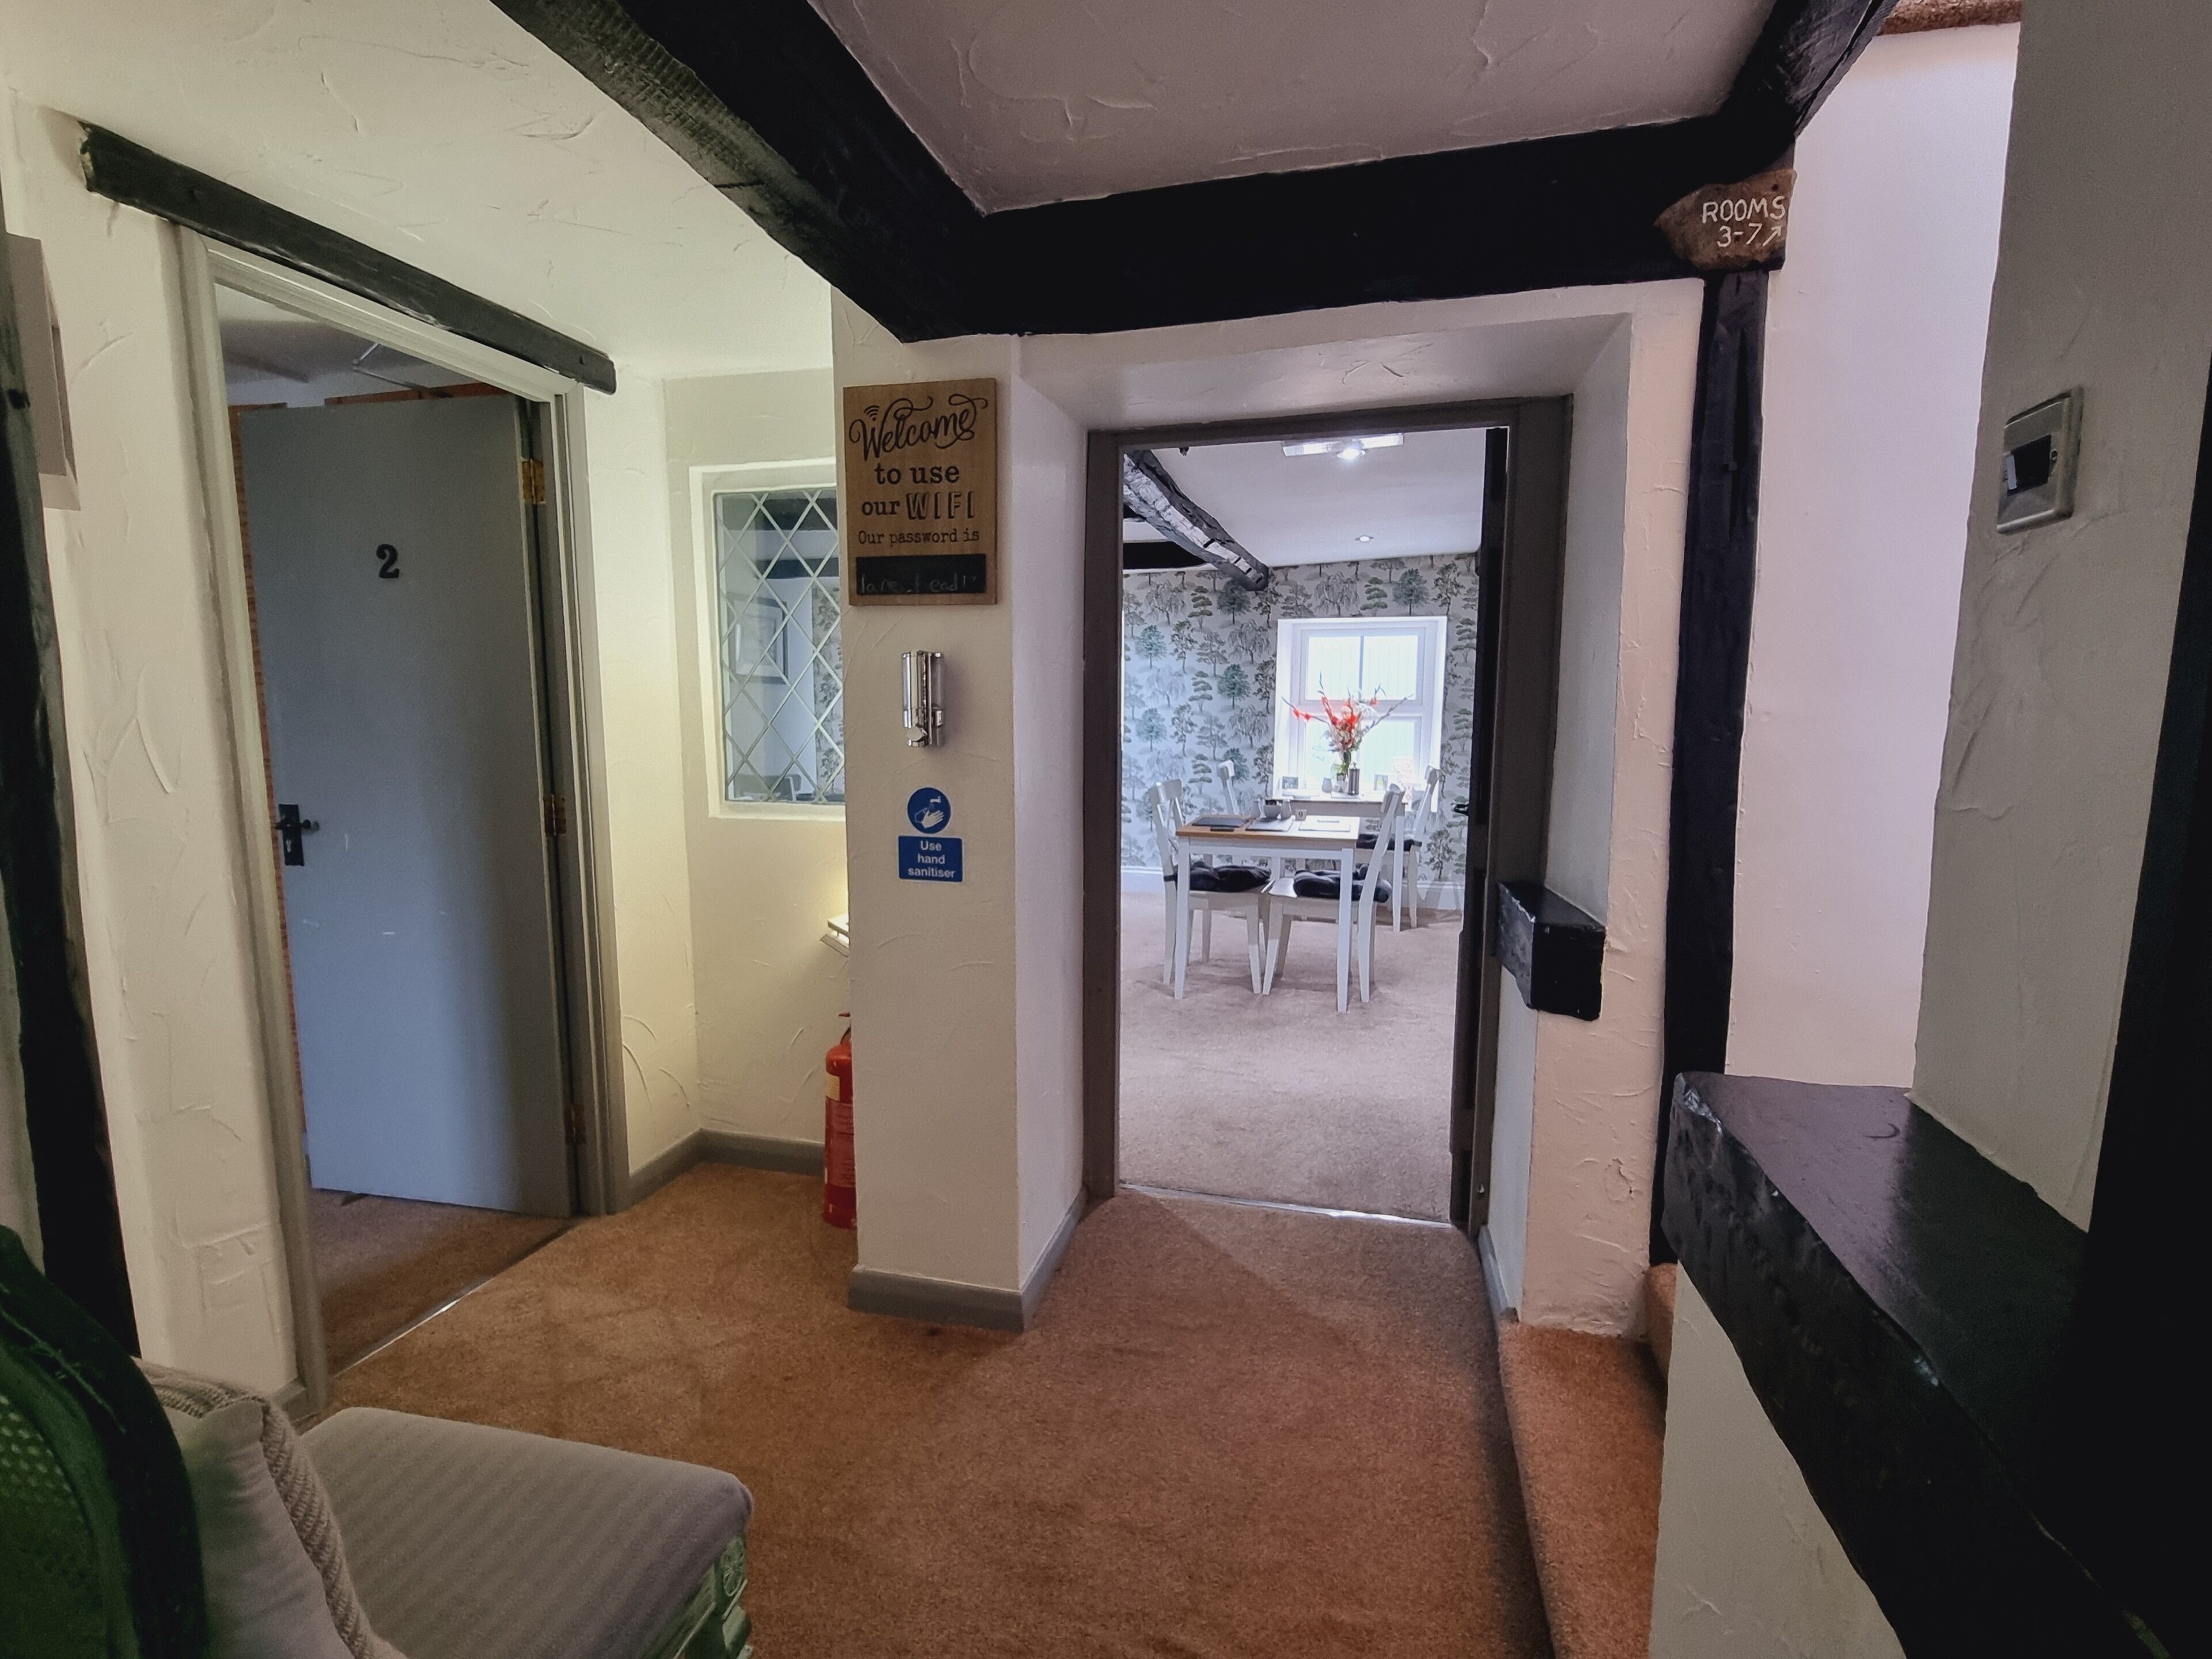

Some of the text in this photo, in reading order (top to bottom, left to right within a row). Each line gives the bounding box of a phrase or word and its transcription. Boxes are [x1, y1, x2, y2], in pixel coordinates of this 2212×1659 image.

[1702, 195, 1786, 224] ROOMS
[1717, 223, 1763, 247] 3-7
[849, 393, 988, 461] Welcome
[874, 463, 960, 485] to use
[861, 491, 975, 520] our WIFI
[858, 528, 980, 547] Our password is
[376, 544, 400, 578] 2
[921, 840, 942, 851] Use
[918, 853, 945, 864] hand
[908, 866, 956, 878] sanitiser
